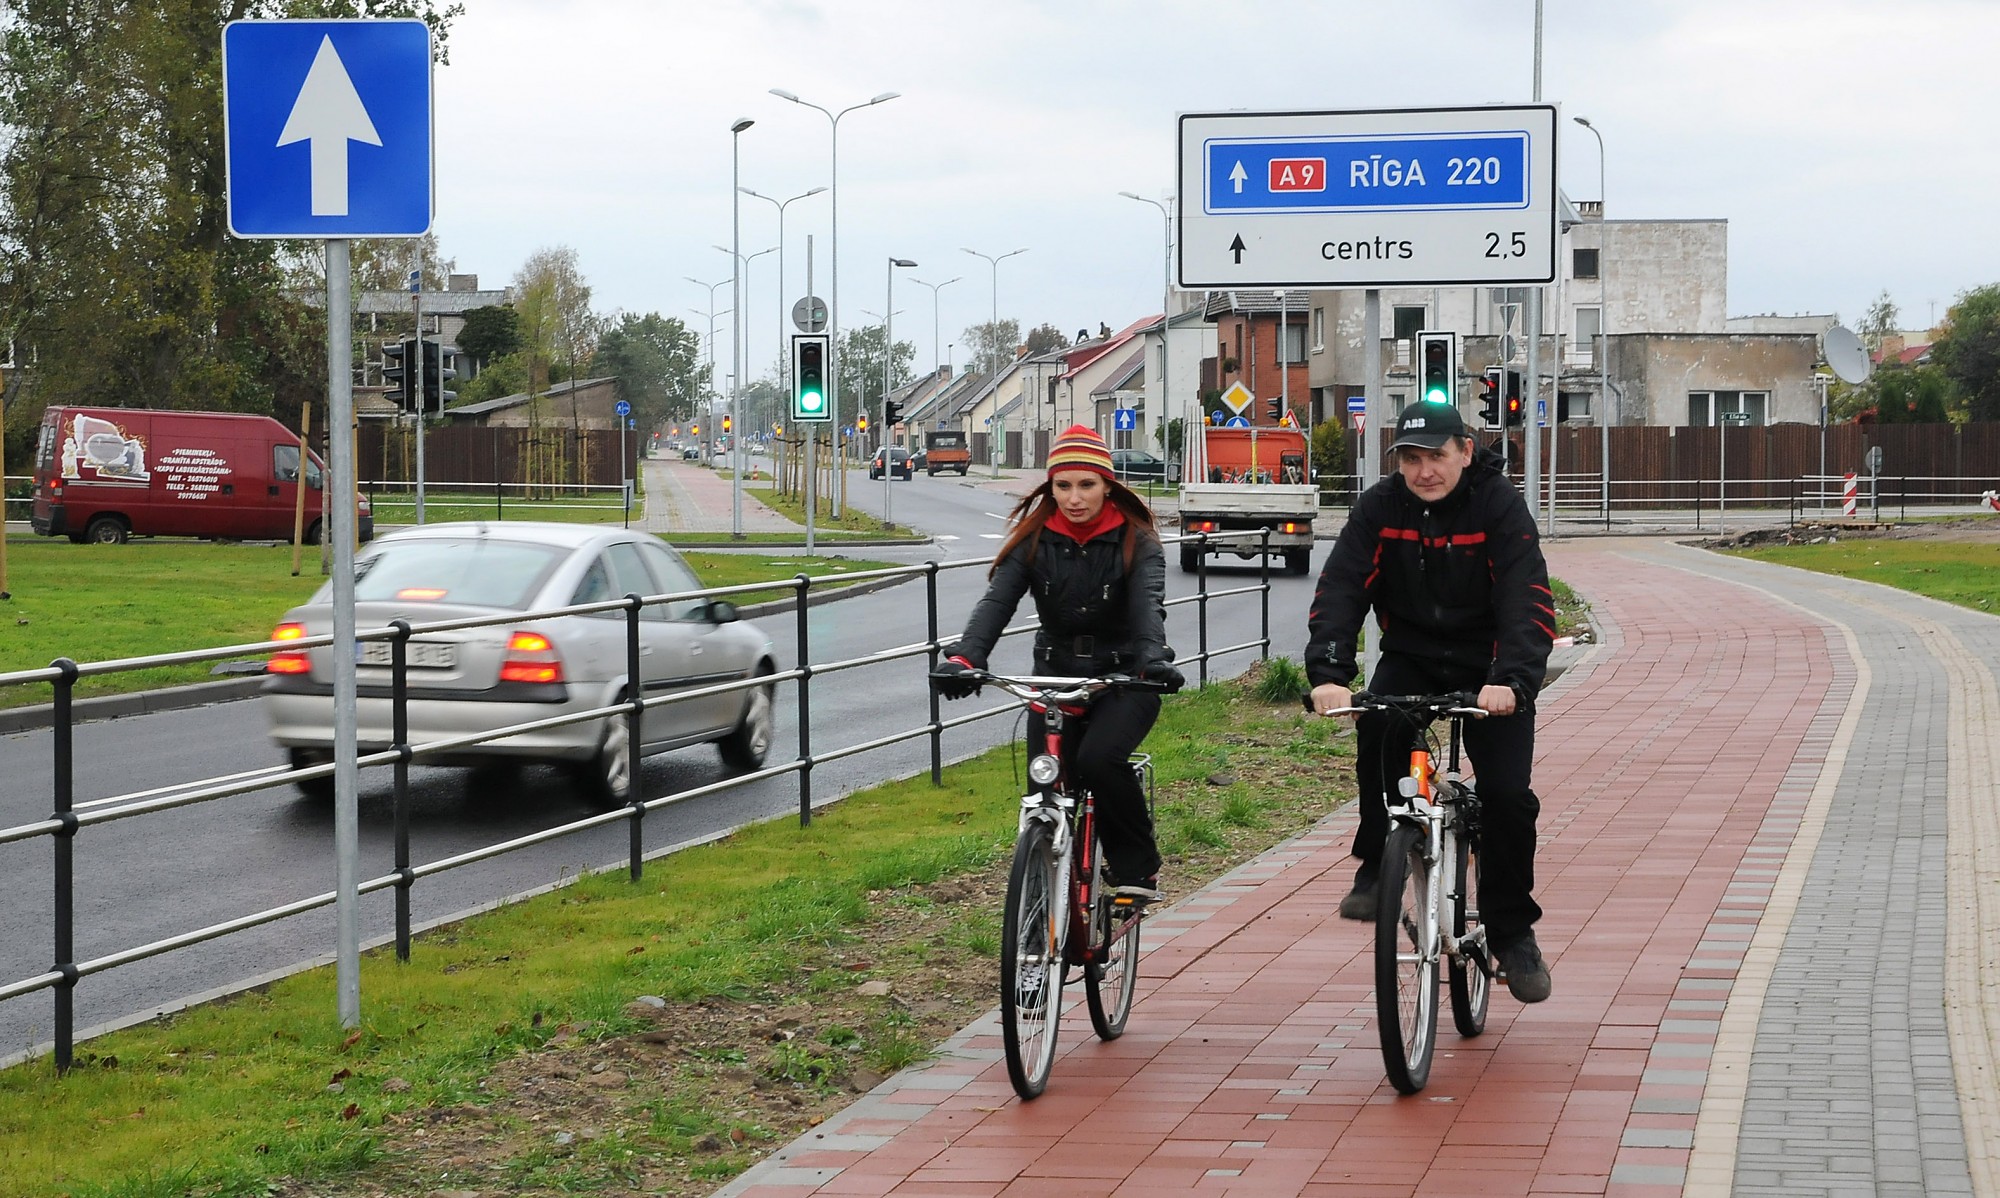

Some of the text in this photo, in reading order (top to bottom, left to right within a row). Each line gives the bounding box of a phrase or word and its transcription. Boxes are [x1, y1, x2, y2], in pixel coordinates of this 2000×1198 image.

[1350, 153, 1426, 188] RĪGA
[1446, 156, 1501, 186] 220
[1321, 231, 1526, 260] centrs 2,5
[1403, 417, 1426, 430] ABB
